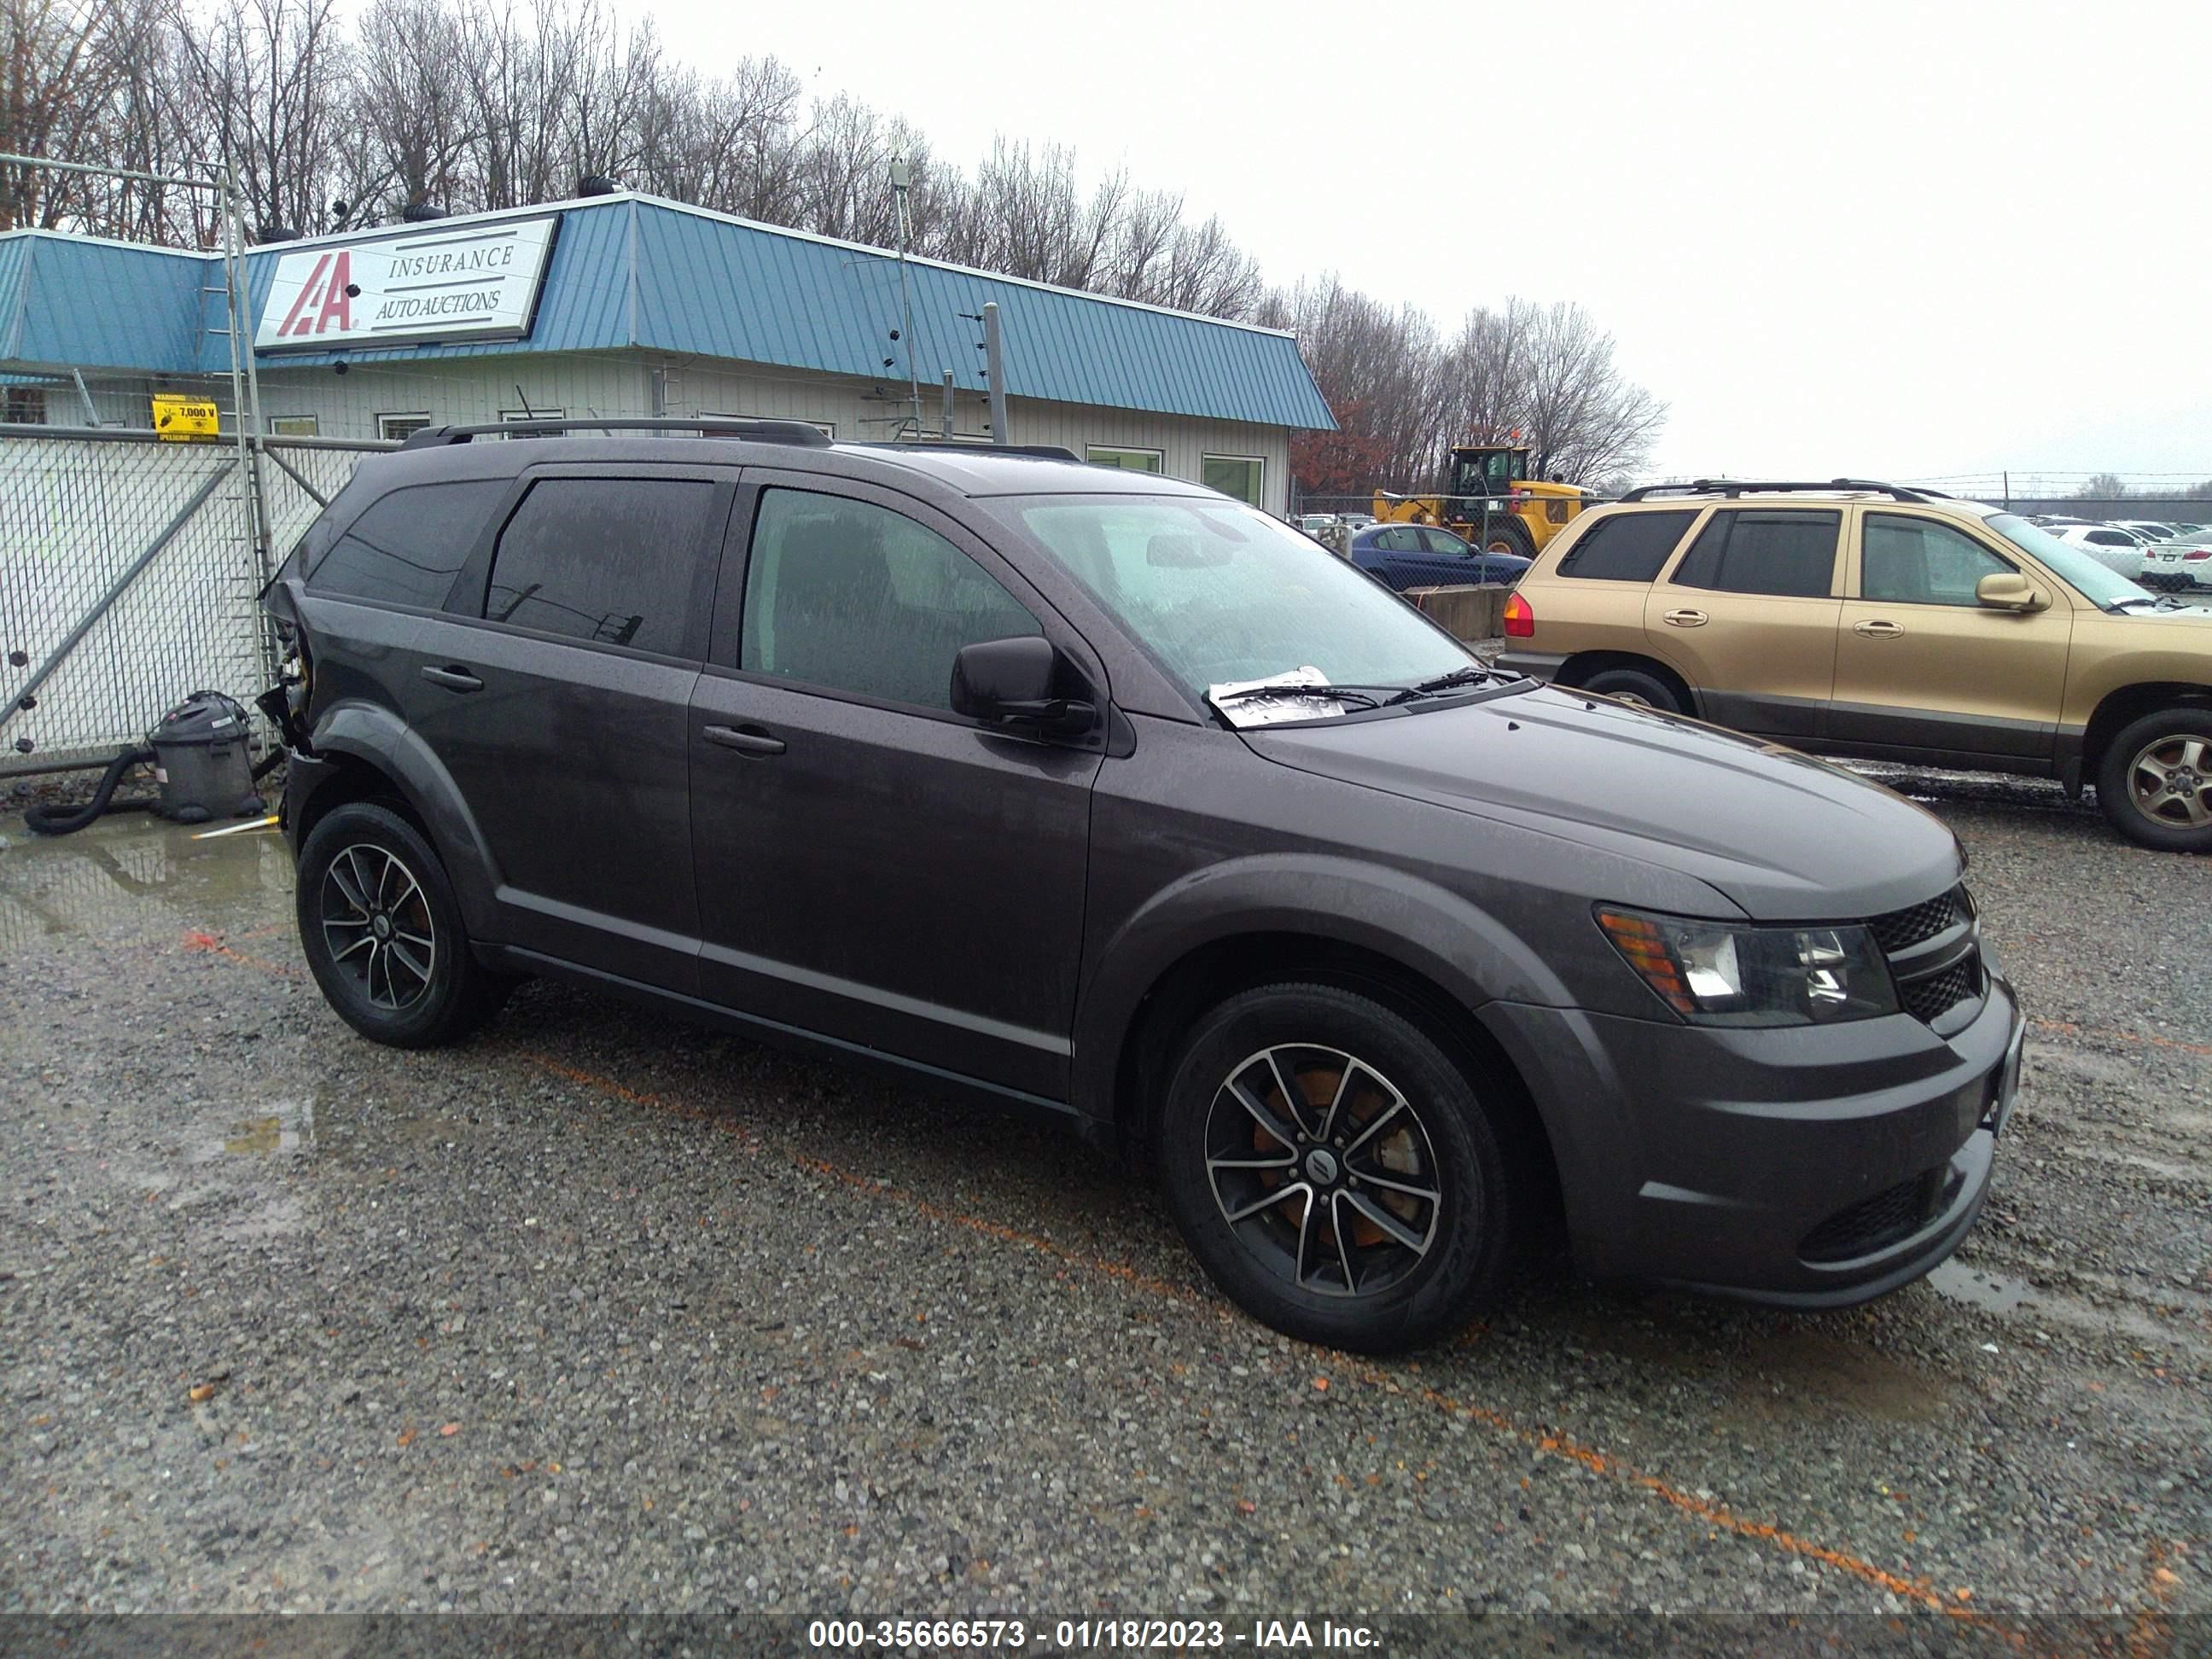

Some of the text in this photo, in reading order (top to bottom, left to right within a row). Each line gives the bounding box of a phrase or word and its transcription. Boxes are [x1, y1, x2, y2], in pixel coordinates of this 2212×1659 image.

[389, 245, 514, 278] INSURANCE
[375, 290, 501, 320] AUTO AUCTIONS
[179, 407, 215, 418] 7,000 V
